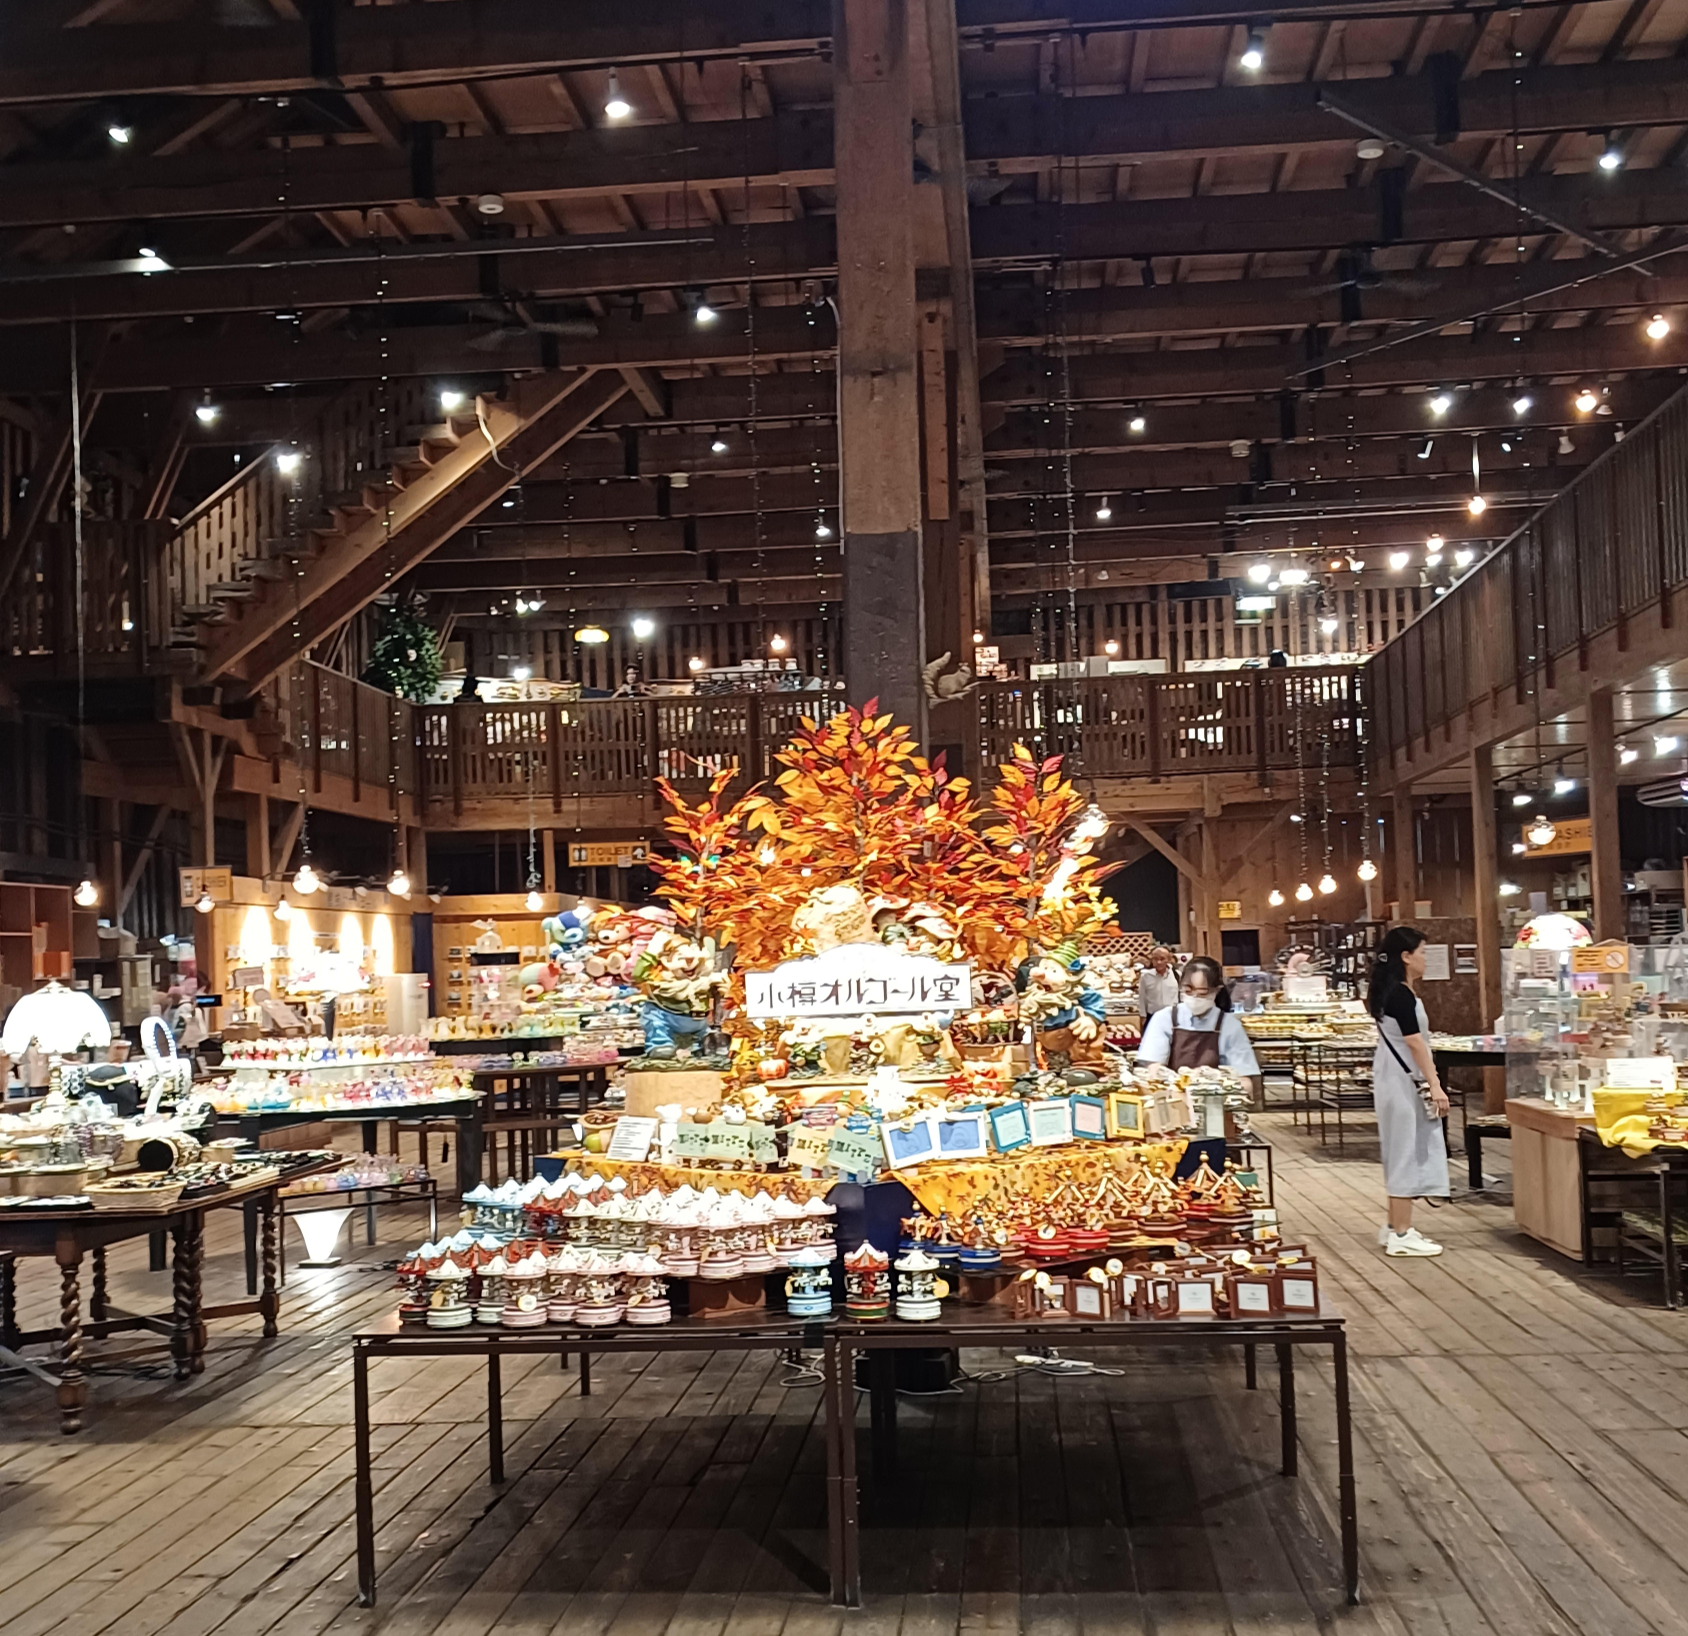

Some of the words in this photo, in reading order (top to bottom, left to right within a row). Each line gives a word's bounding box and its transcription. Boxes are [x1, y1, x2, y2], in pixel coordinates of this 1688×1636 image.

[589, 846, 630, 856] TOILET
[757, 973, 961, 1009] 小樽オルゴール堂
